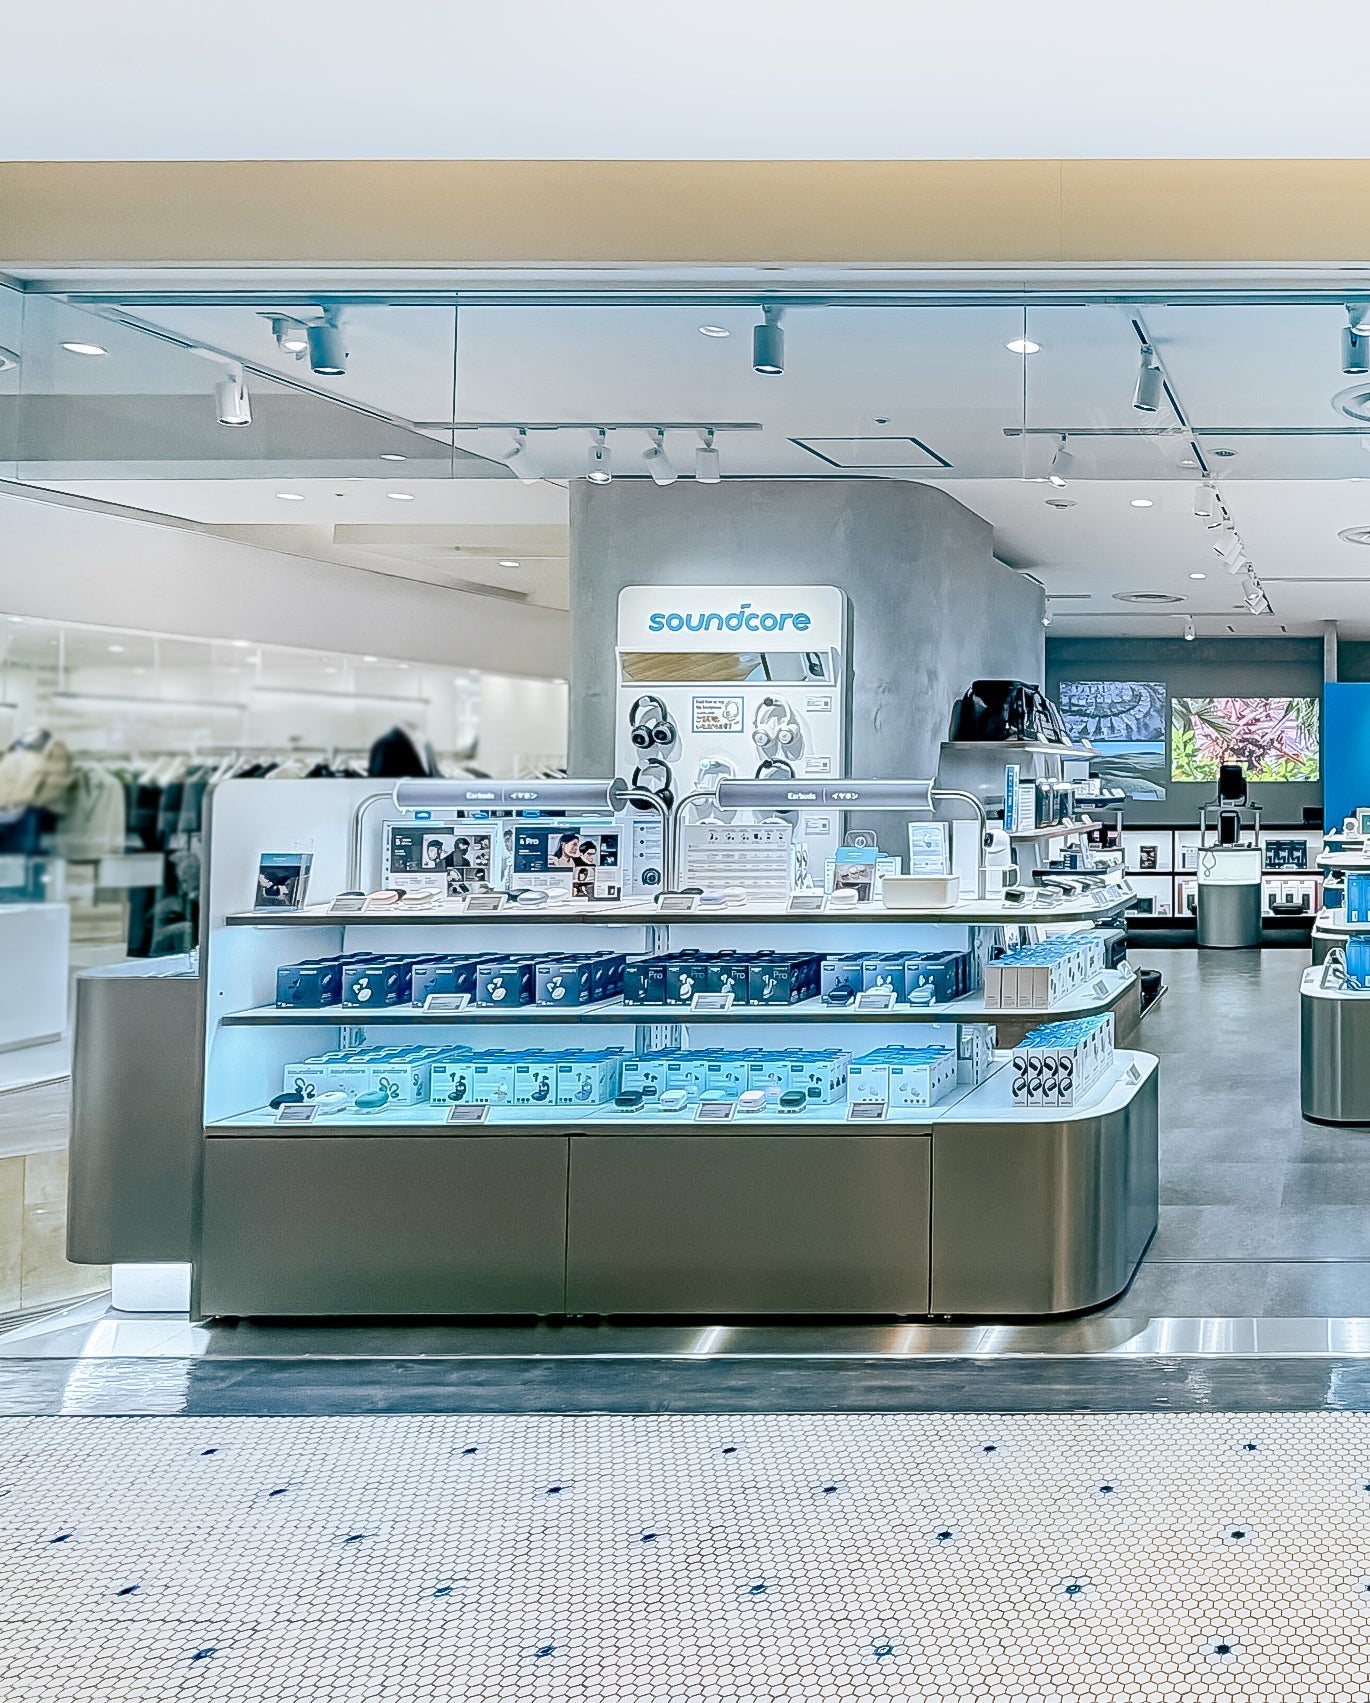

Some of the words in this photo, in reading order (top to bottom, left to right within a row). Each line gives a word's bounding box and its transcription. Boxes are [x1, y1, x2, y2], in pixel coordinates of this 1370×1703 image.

[648, 603, 812, 632] soundcore
[648, 971, 663, 979] Pro
[731, 971, 746, 979] Pro
[773, 971, 788, 979] Pro
